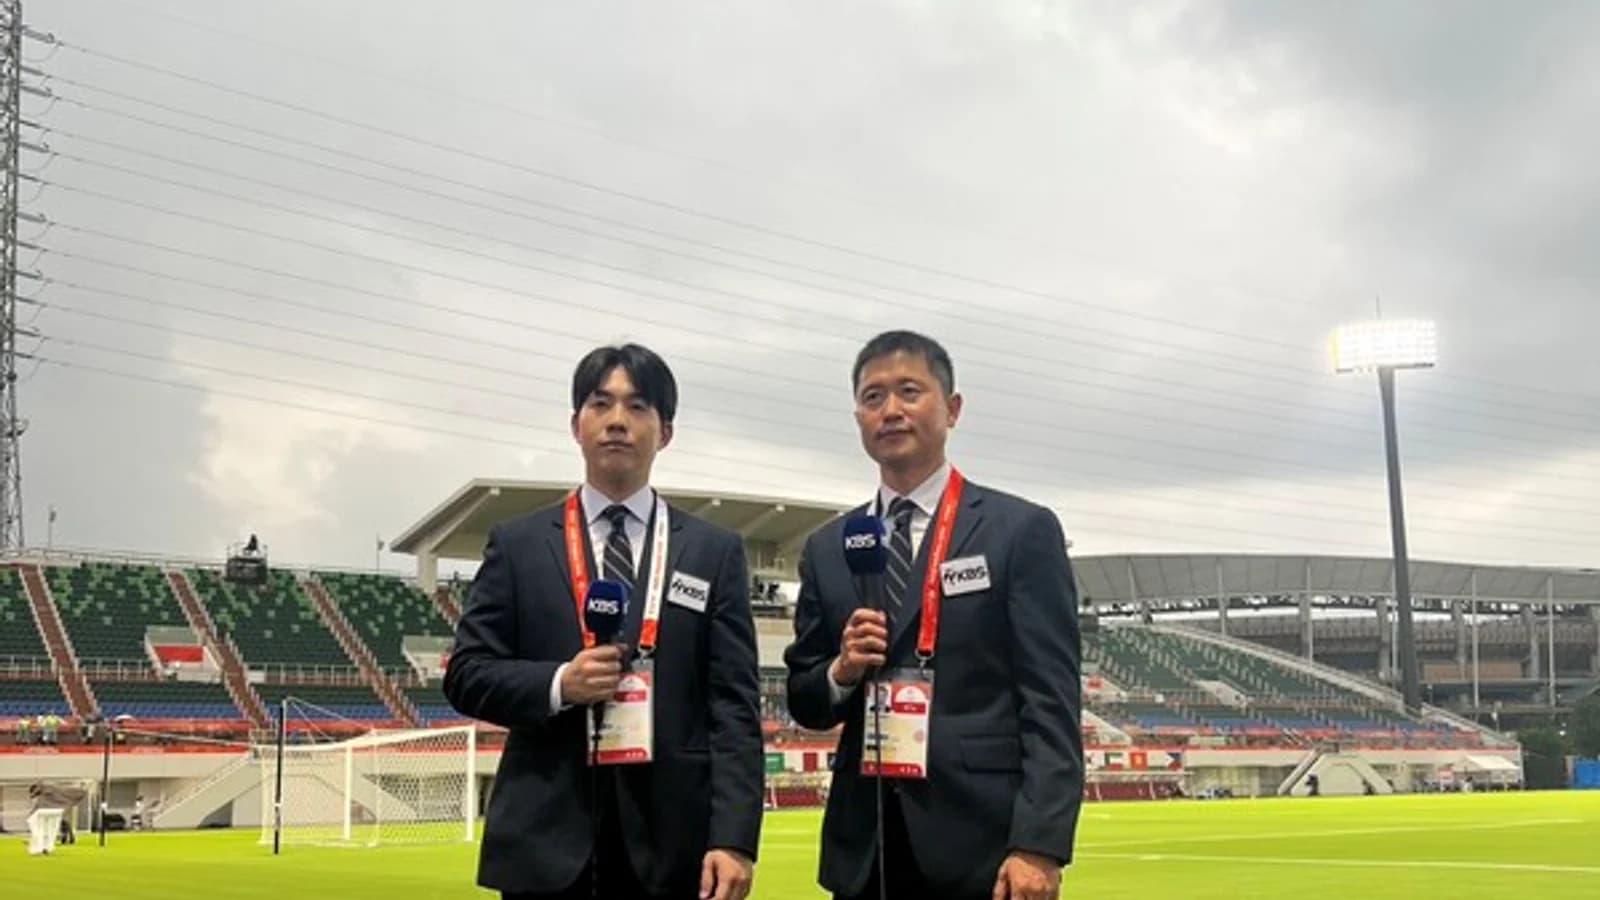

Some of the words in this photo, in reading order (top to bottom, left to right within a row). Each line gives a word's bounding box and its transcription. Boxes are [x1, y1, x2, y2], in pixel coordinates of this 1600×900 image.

[845, 533, 876, 550] KBS
[957, 565, 986, 583] KBS
[588, 598, 620, 615] KBS
